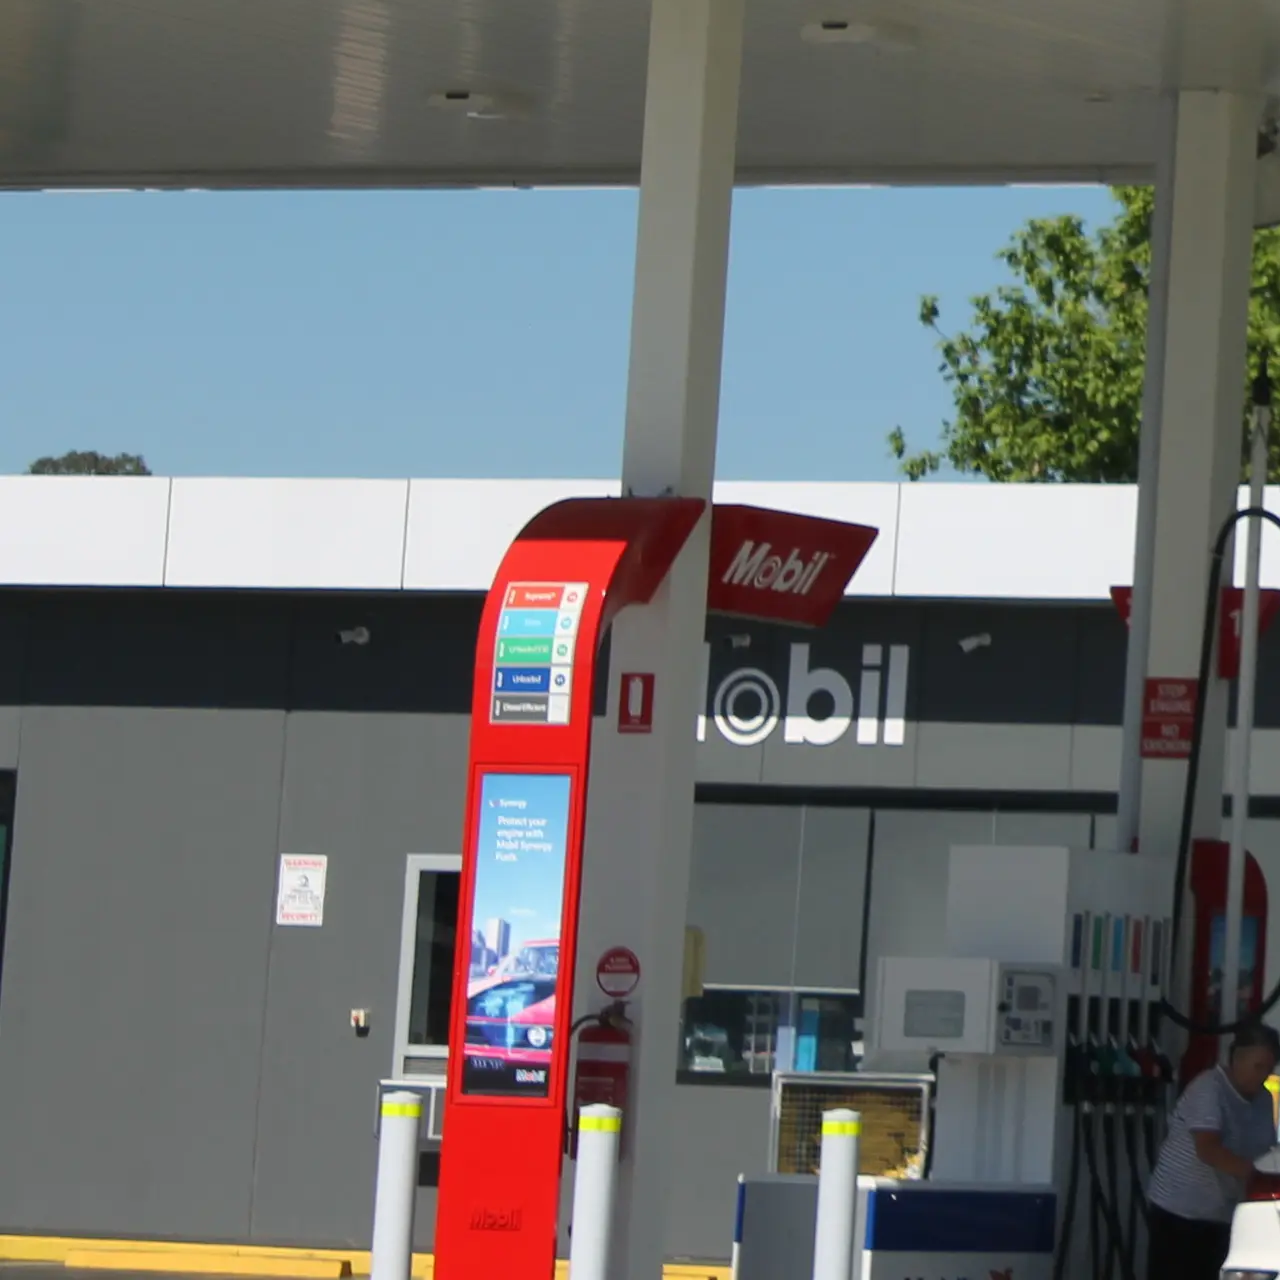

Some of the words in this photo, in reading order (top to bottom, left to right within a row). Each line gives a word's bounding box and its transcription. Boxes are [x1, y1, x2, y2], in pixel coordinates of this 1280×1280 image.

[722, 540, 830, 596] Mobil
[696, 642, 909, 745] obil
[1157, 684, 1188, 698] STOP
[516, 1069, 547, 1083] Mobil
